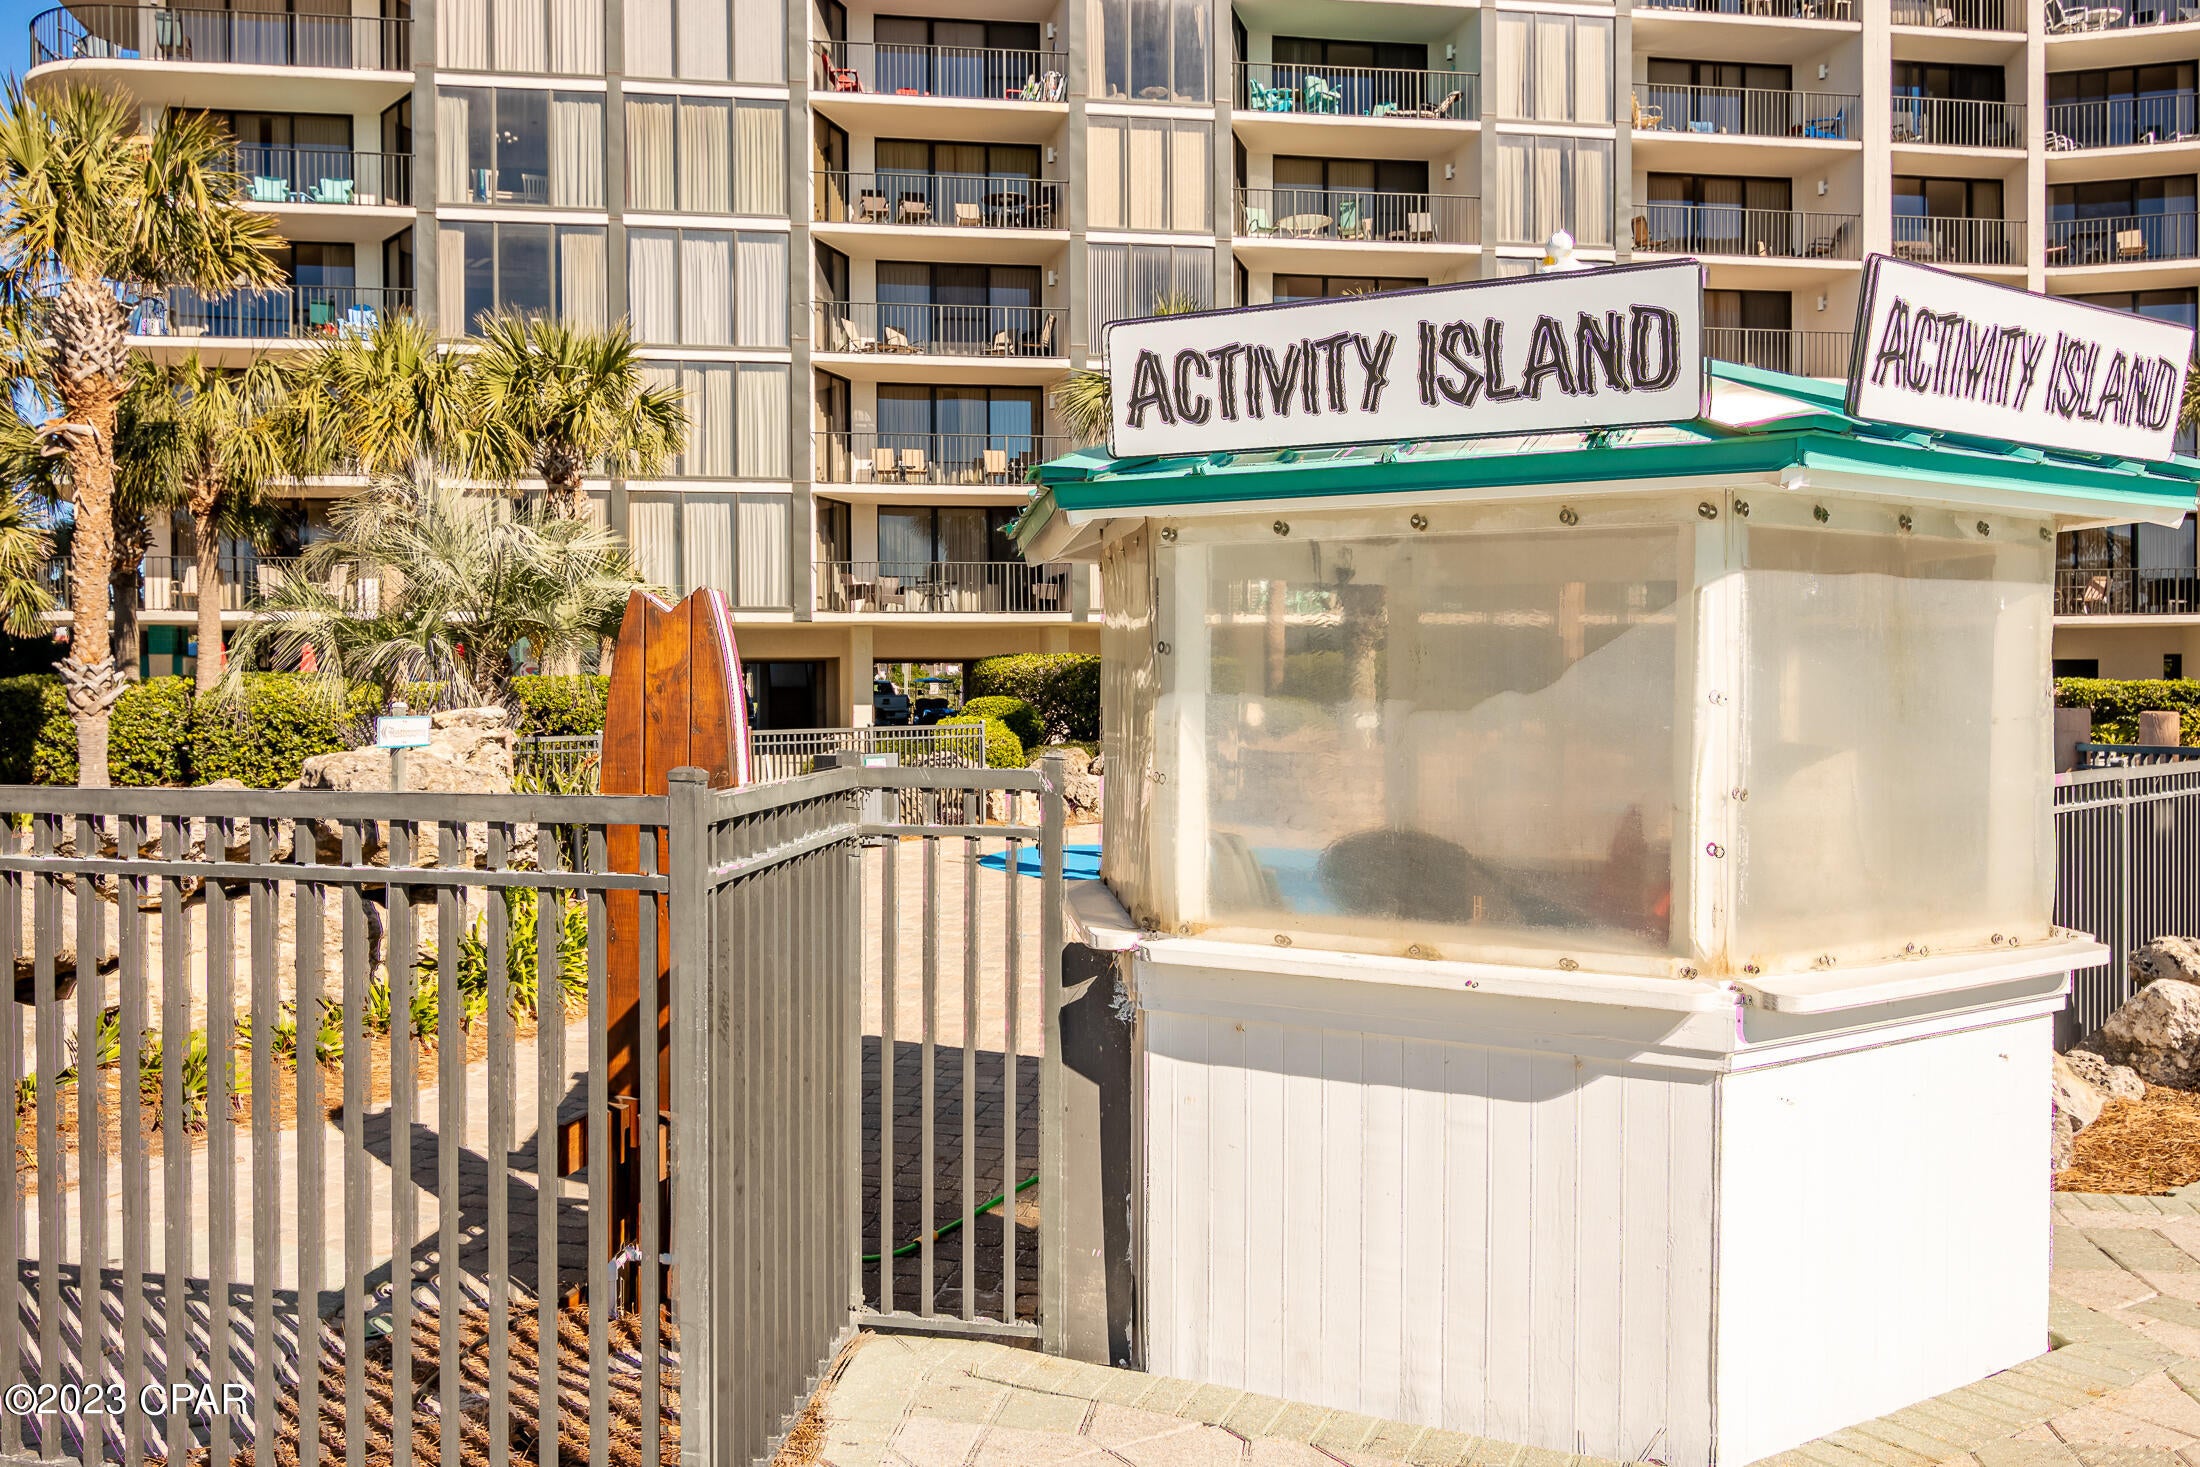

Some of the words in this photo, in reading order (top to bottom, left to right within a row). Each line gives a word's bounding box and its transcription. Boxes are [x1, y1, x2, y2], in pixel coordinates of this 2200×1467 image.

[1125, 330, 1397, 429] ACTIVITY
[1418, 304, 1683, 409] ISLAND
[1870, 295, 2046, 412] ACTIVITY
[2044, 330, 2178, 432] ISLAND
